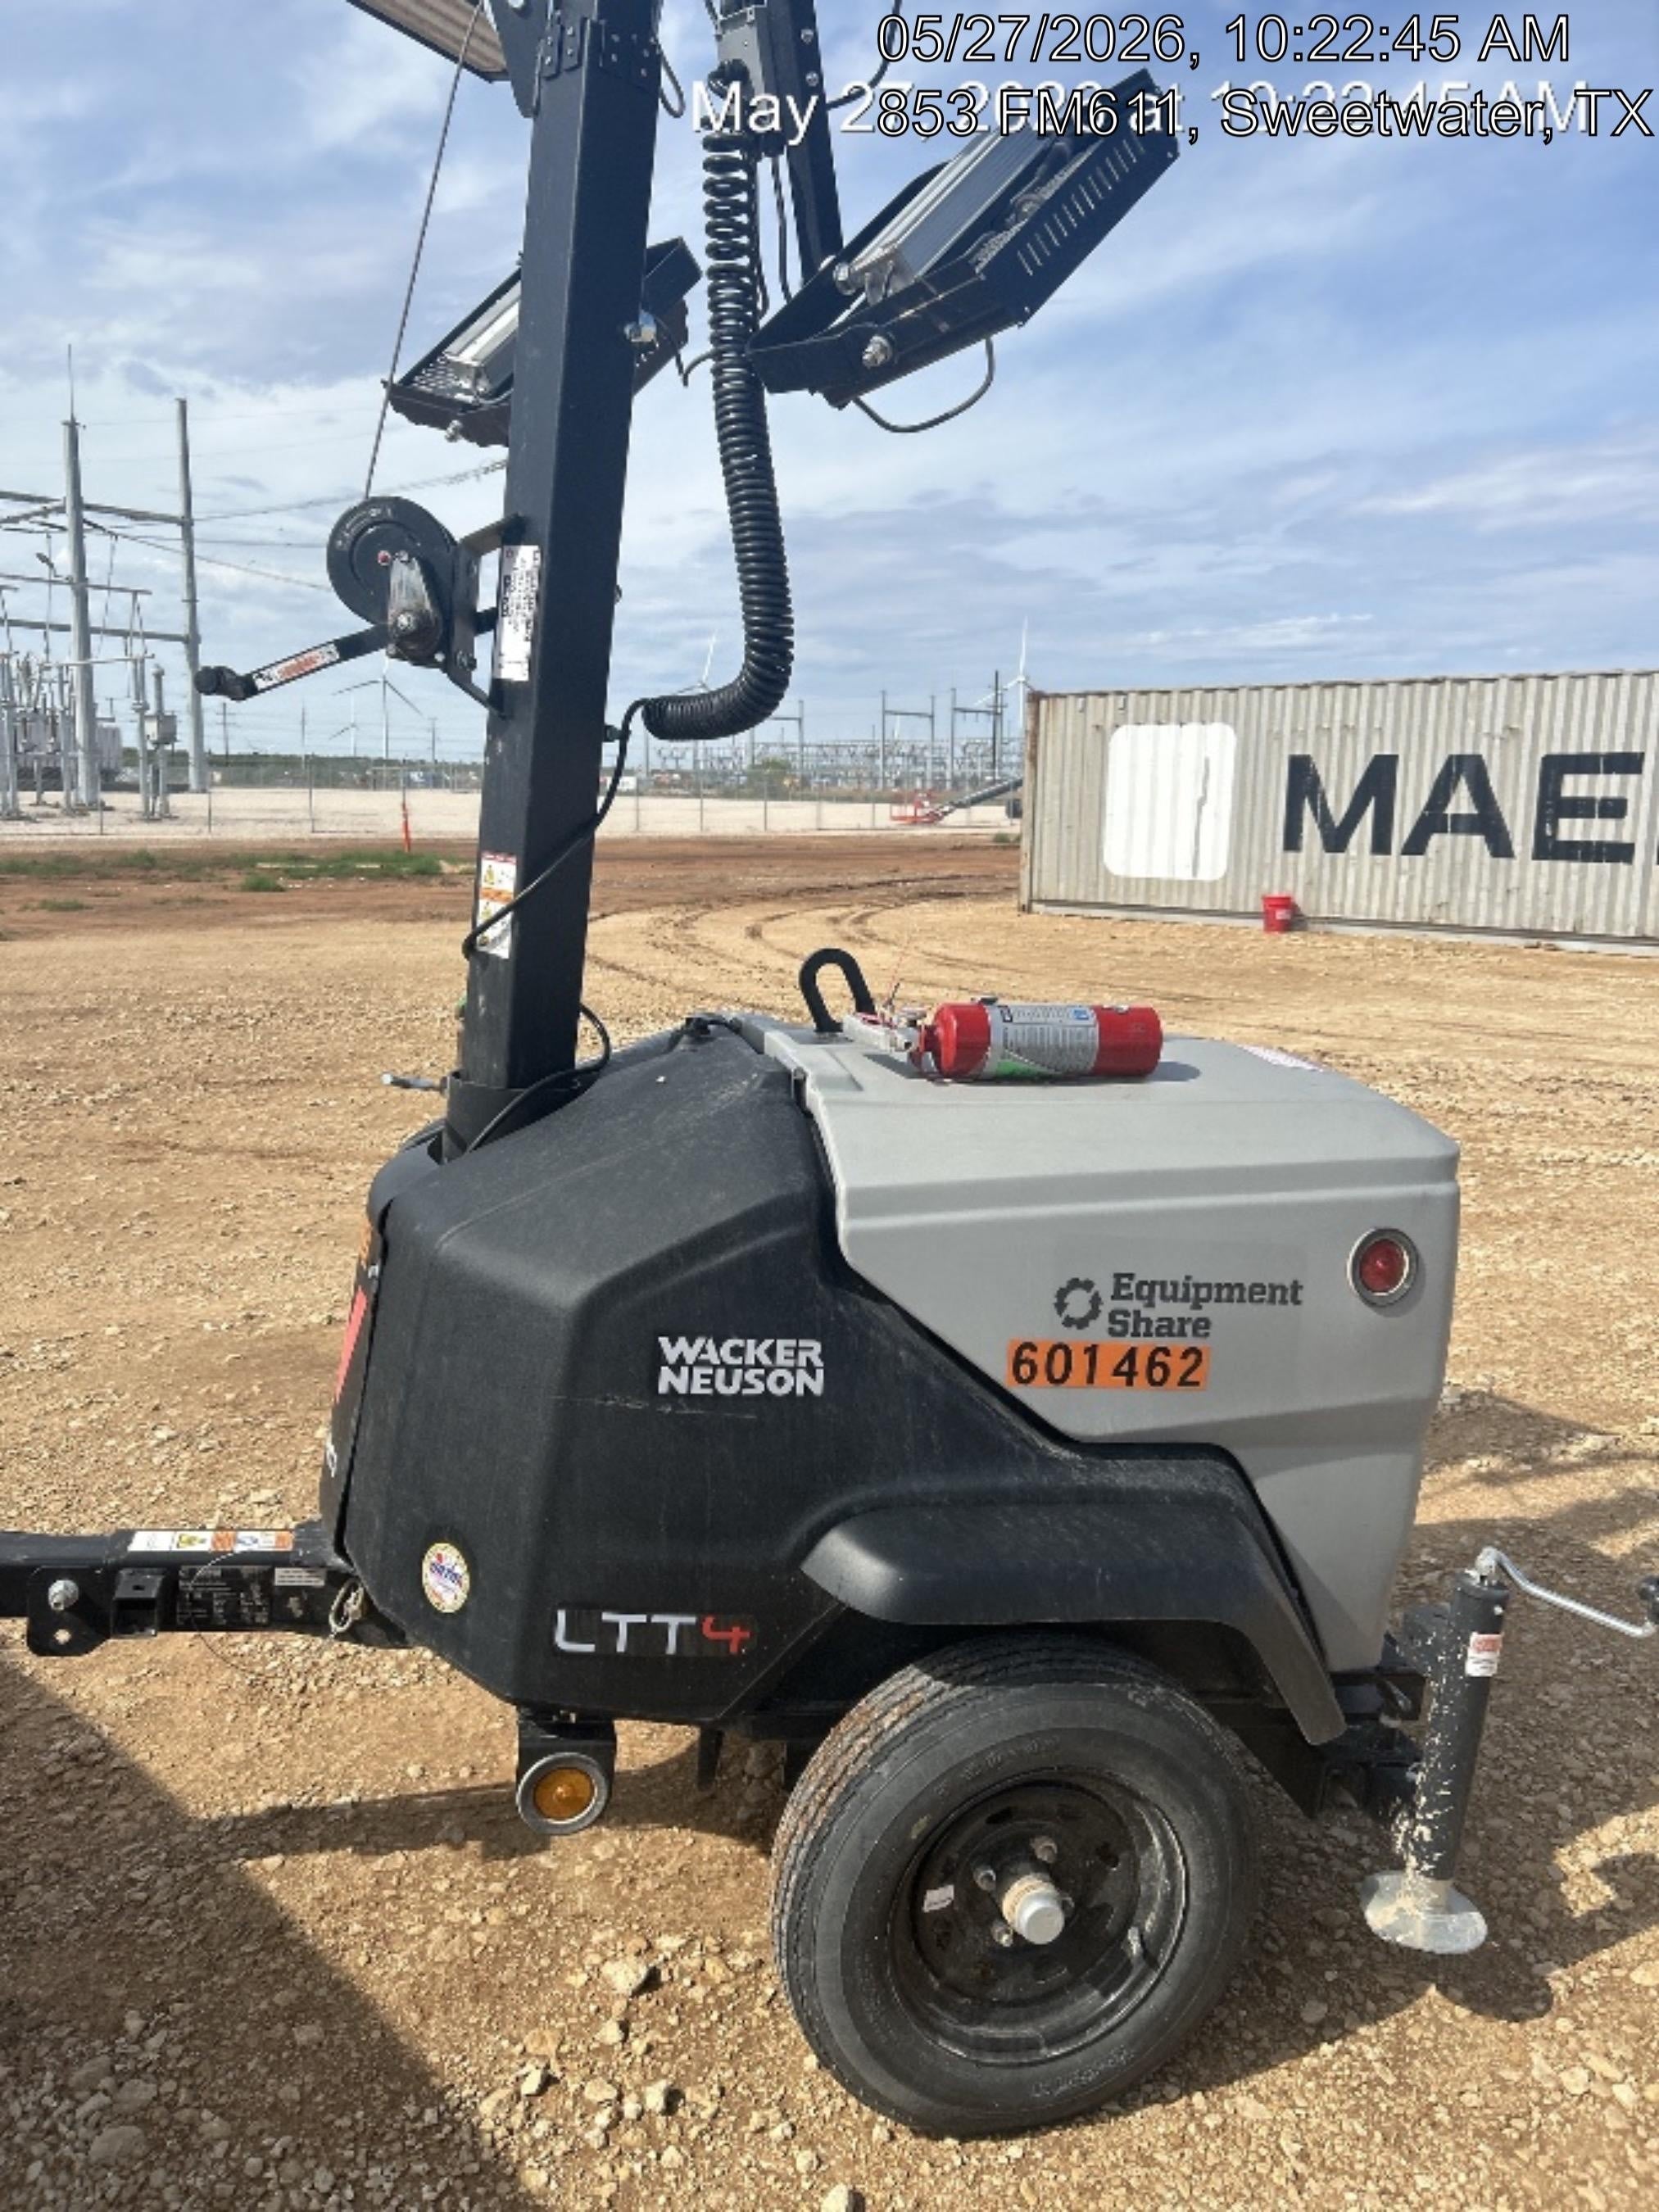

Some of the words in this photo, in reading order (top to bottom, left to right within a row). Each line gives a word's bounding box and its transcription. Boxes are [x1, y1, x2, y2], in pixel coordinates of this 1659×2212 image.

[1283, 751, 1659, 866] MAE
[1110, 1272, 1303, 1310] Equipment
[1108, 1308, 1212, 1339] Share
[658, 1336, 823, 1367] WACKER
[1012, 1341, 1204, 1388] 601462
[658, 1366, 824, 1397] NEUSON
[554, 1609, 750, 1655] LTT4
